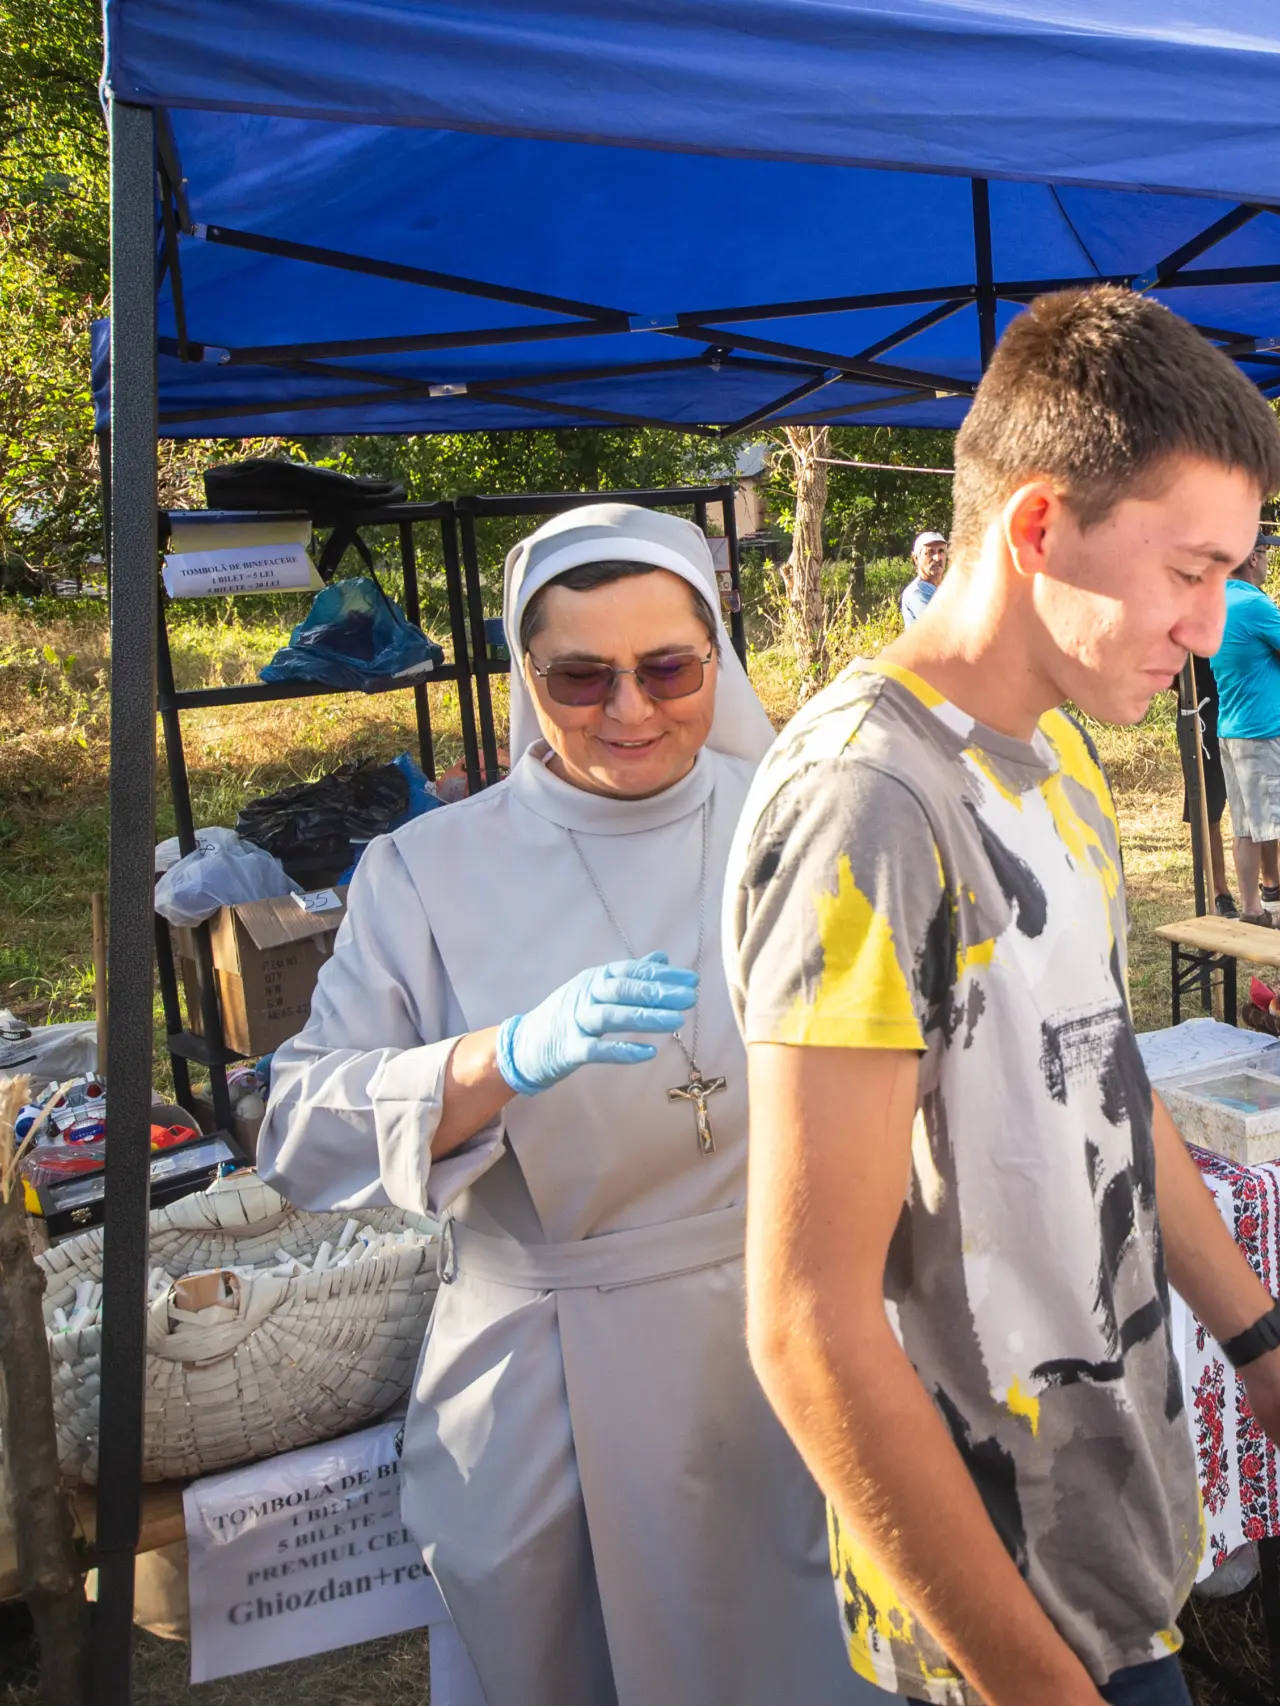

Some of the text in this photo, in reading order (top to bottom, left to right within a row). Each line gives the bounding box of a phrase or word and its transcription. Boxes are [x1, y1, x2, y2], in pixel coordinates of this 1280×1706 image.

[180, 556, 298, 577] TOMBOLĂ DE BINEFACERE
[218, 574, 245, 583] BILET
[259, 570, 274, 578] LEI
[213, 584, 246, 593] BILETE
[341, 1469, 371, 1490] DE
[292, 1513, 299, 1527] 1
[277, 1539, 289, 1554] 5
[296, 1511, 376, 1548] BILETE
[246, 1543, 364, 1587] PREMIUL
